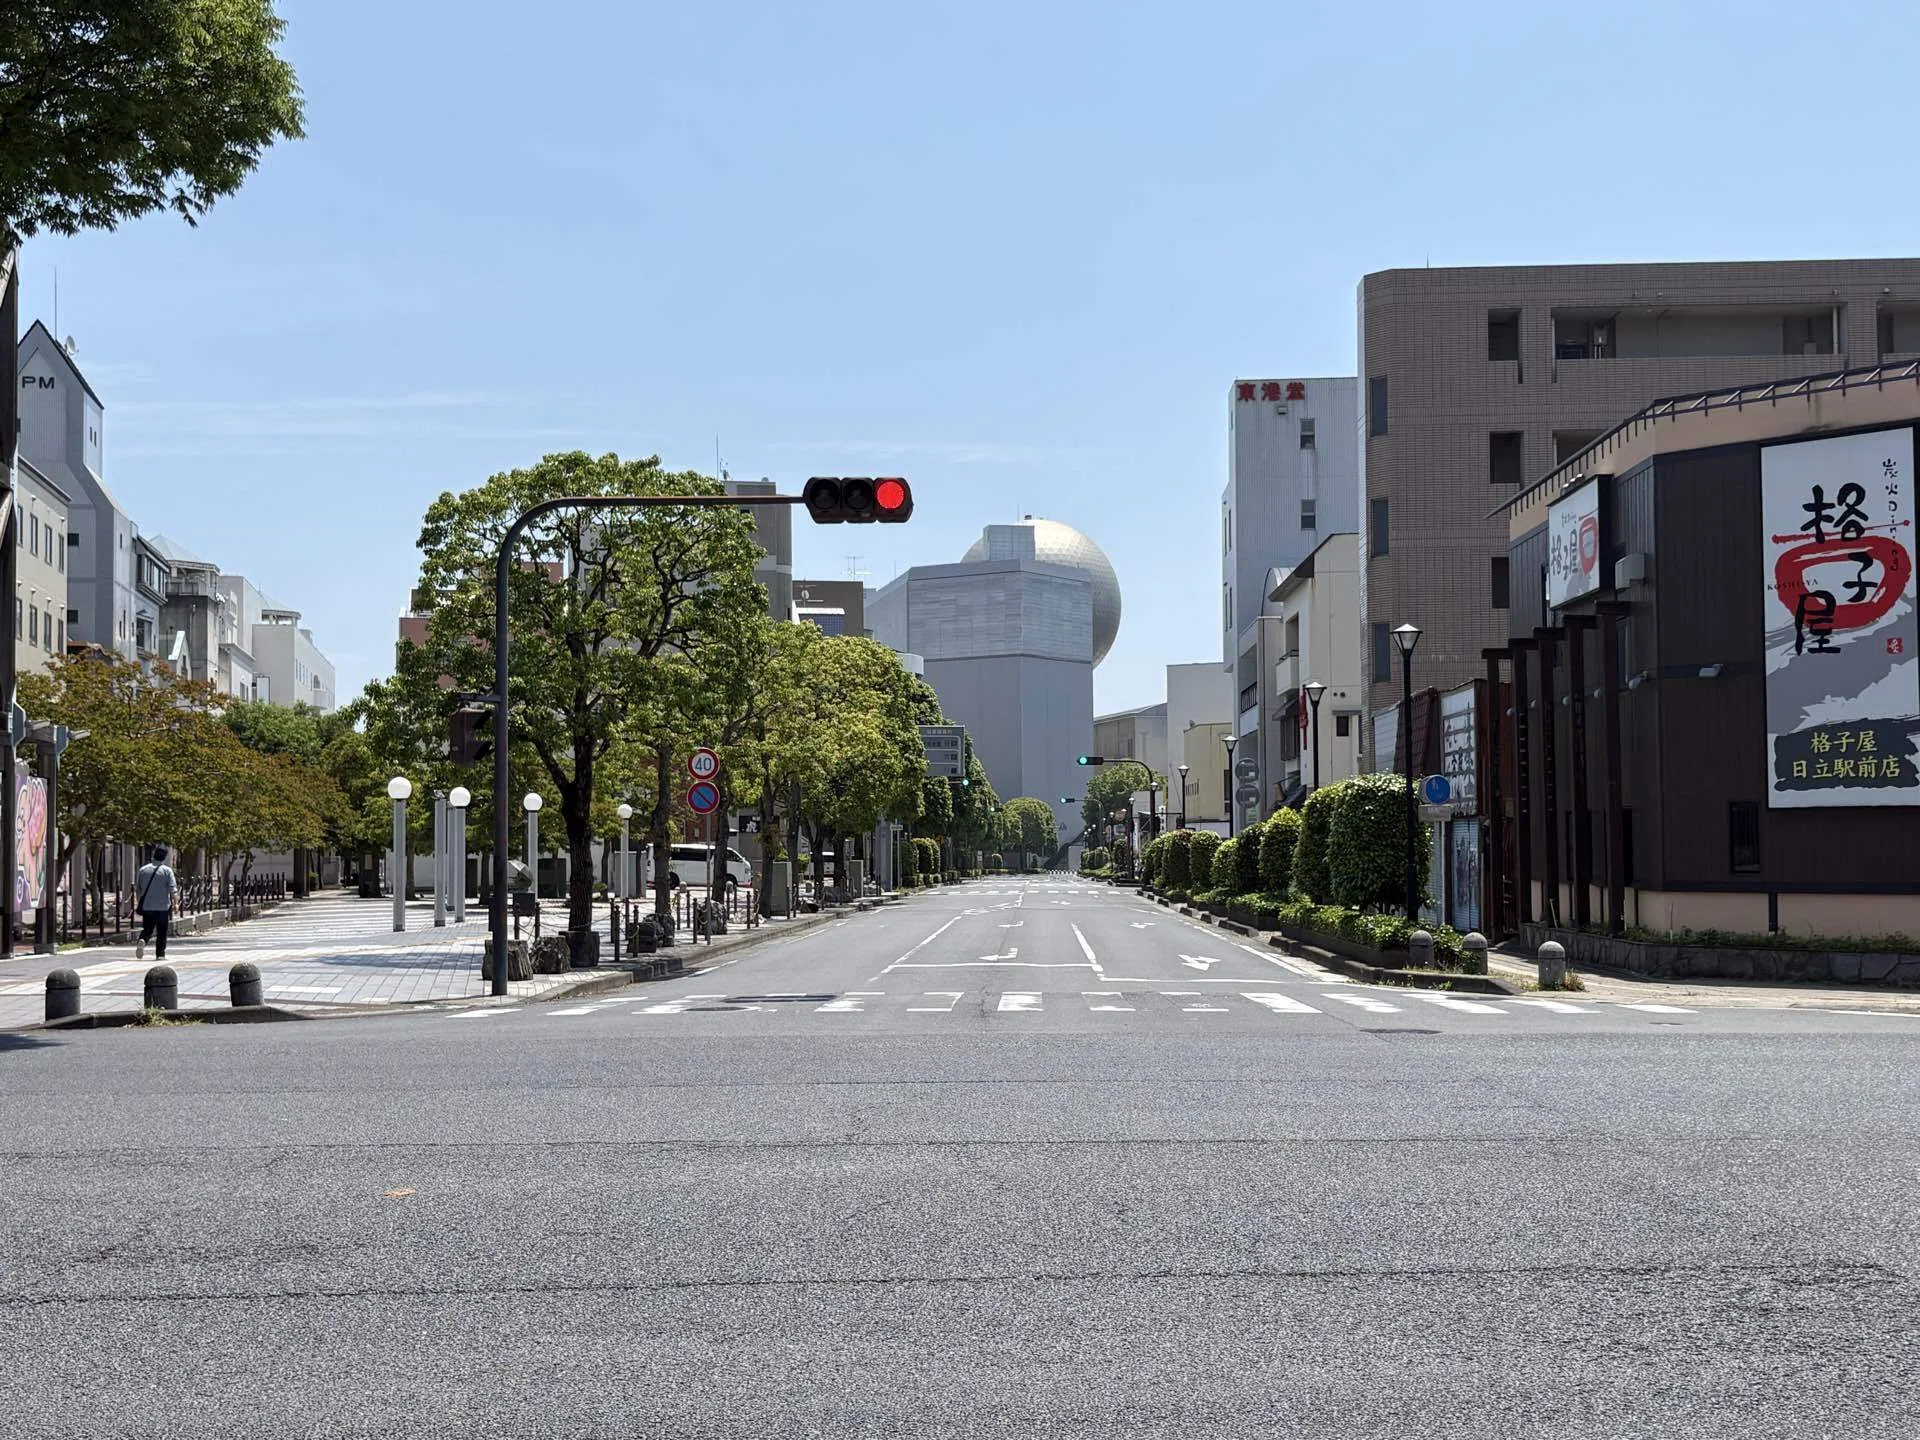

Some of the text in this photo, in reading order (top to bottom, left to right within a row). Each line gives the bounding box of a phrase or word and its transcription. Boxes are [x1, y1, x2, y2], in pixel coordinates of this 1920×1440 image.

[22, 376, 55, 389] PM
[1795, 482, 1878, 656] 格子屋
[1810, 730, 1878, 754] 格子屋
[695, 757, 712, 771] 40
[1793, 755, 1901, 778] 日立駅前店
